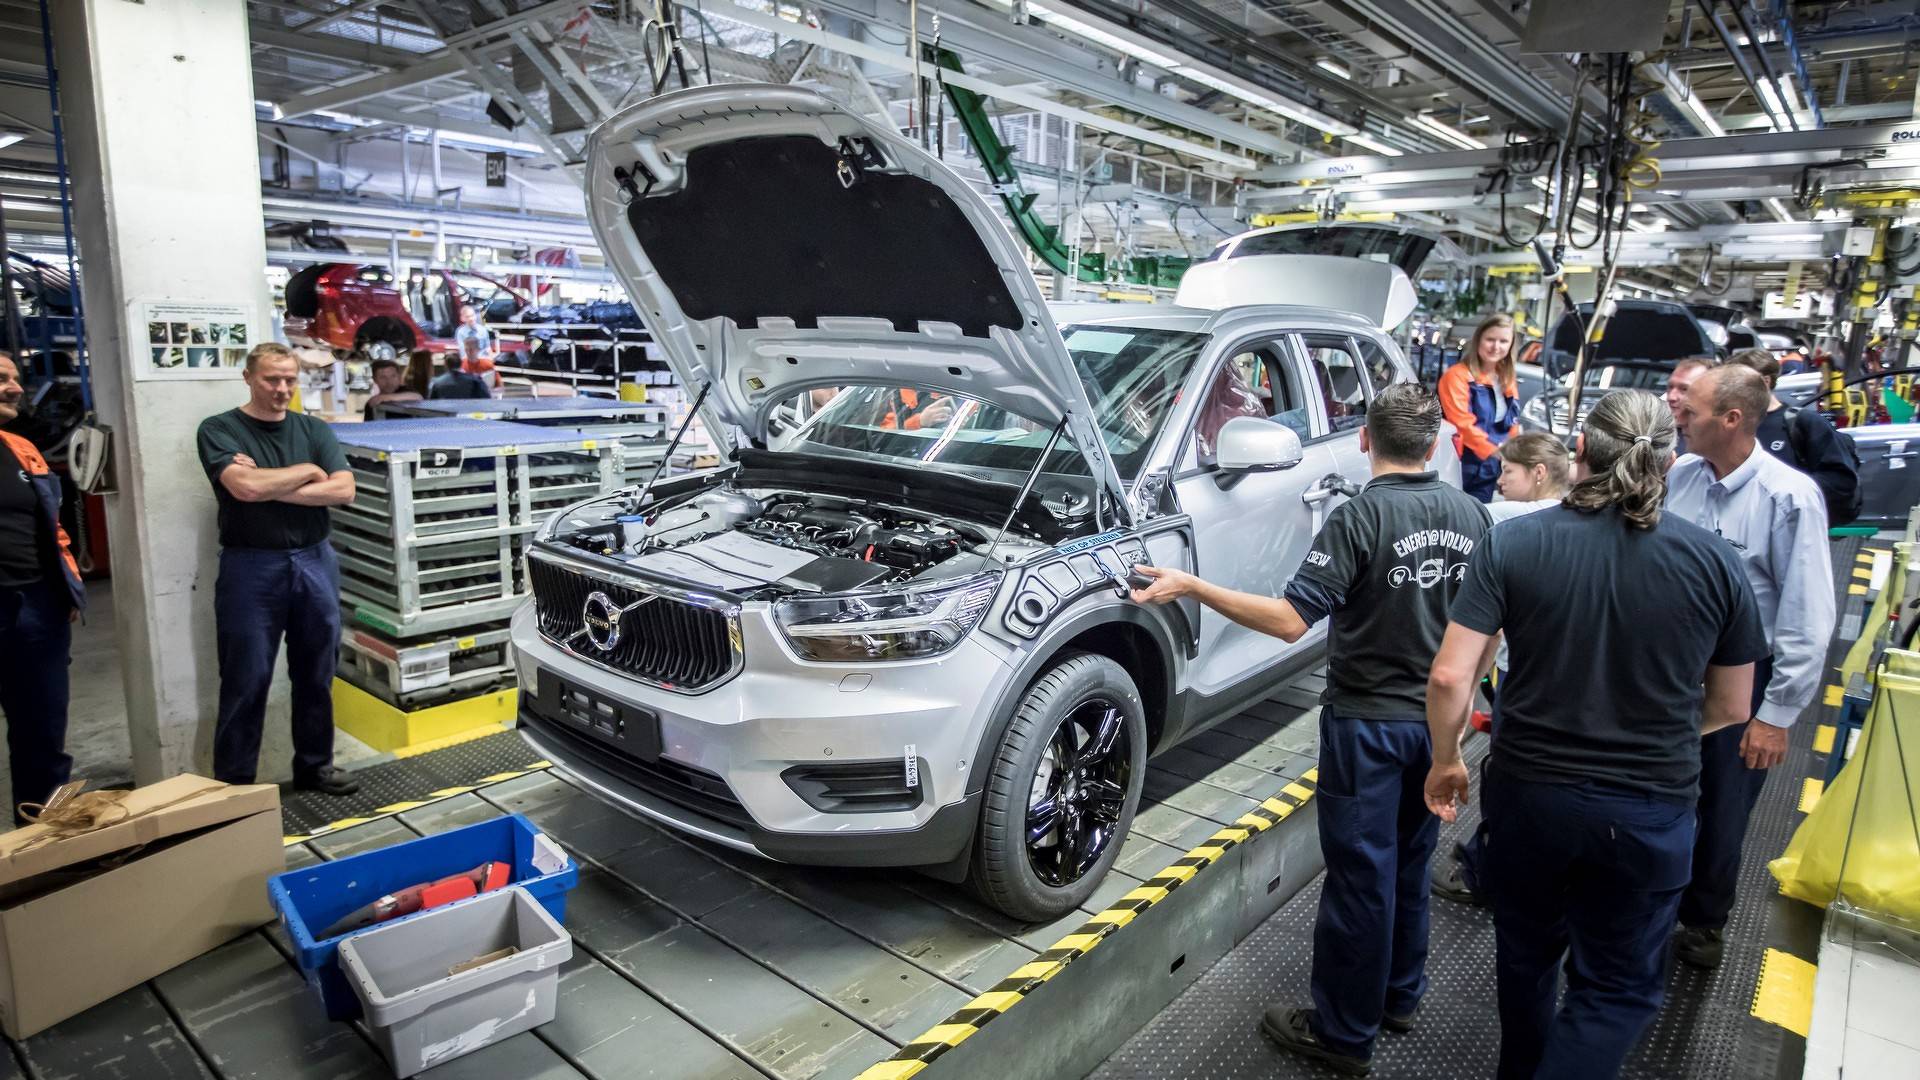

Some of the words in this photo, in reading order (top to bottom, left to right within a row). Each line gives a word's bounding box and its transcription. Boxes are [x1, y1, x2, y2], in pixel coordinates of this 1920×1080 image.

[488, 160, 504, 179] E04
[435, 452, 448, 466] D
[586, 615, 609, 629] VOLVO
